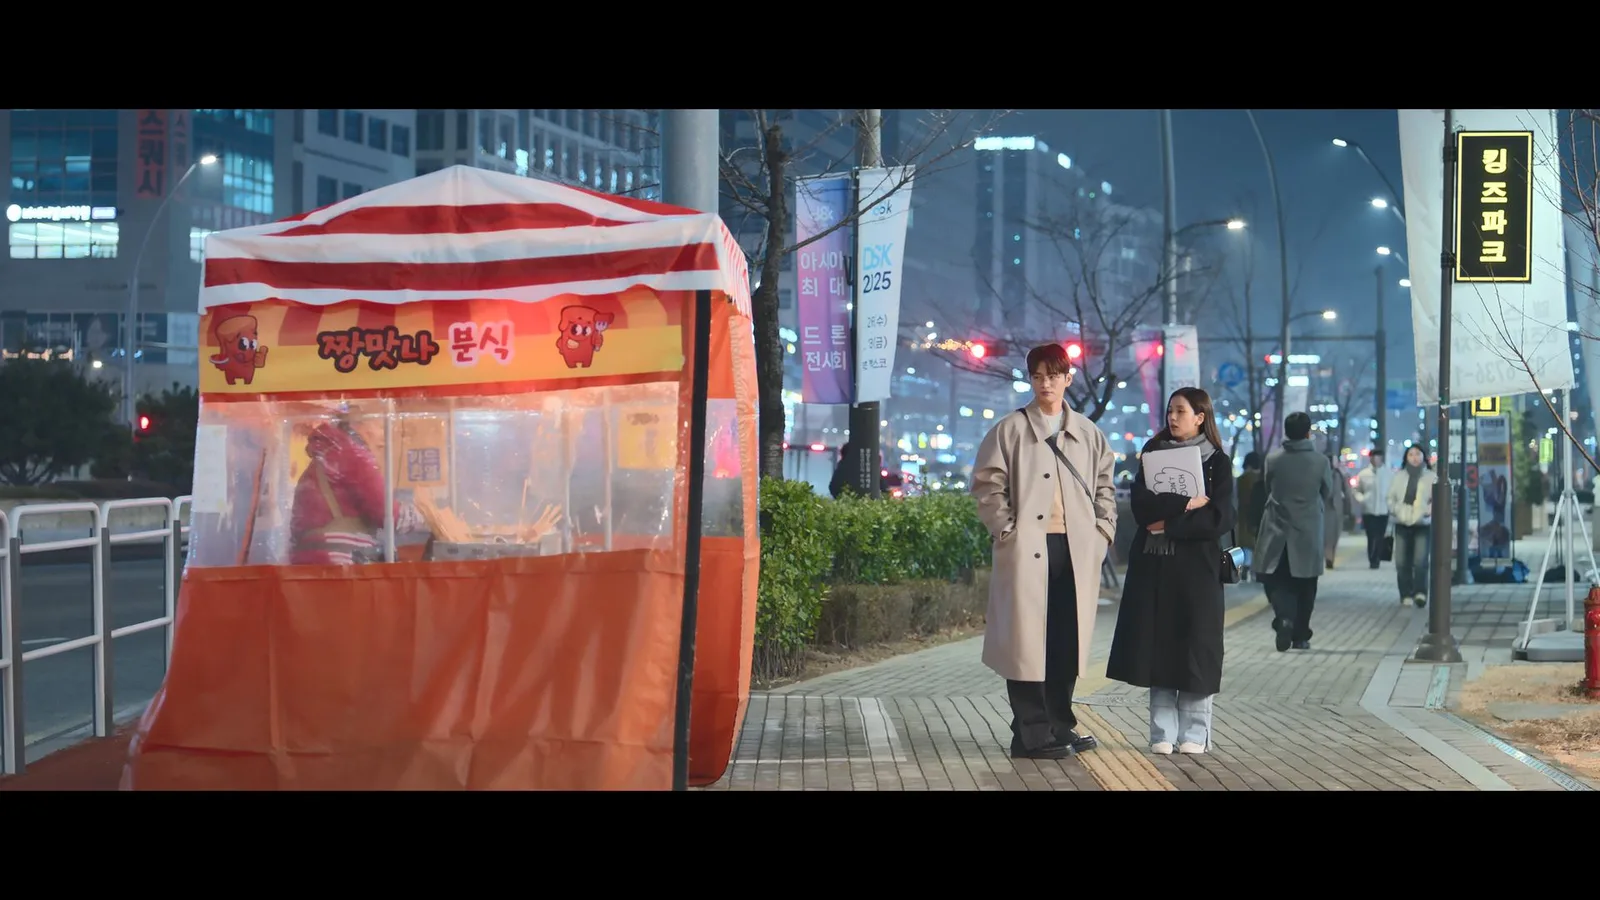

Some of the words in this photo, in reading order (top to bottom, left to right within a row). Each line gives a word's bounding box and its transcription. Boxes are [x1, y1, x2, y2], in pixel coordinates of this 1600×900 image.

[1480, 148, 1508, 263] 킹즈파크
[800, 251, 844, 273] 아시아
[318, 327, 438, 372] 짱맛나
[450, 323, 513, 365] 분식
[805, 351, 847, 372] 전시회
